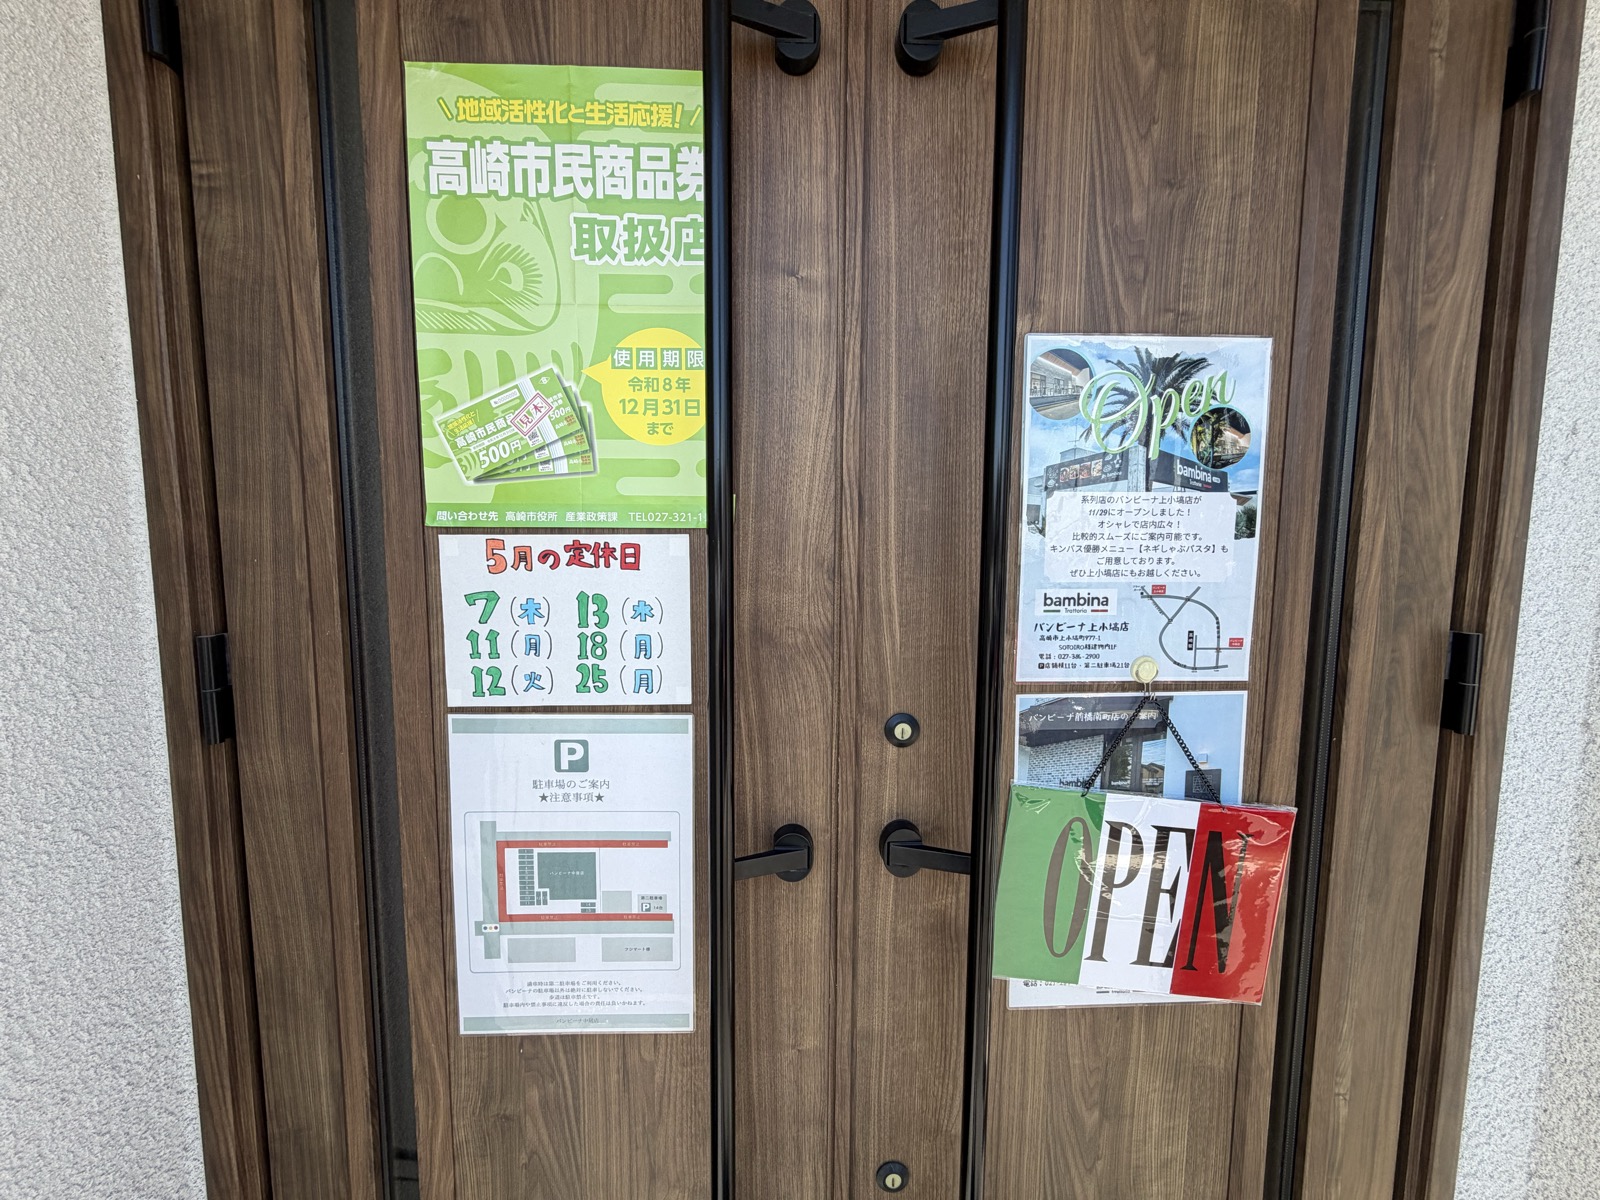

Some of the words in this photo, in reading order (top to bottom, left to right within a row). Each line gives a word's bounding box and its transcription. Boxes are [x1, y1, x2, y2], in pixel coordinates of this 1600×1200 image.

[570, 212, 704, 266] 取扱店
[612, 348, 705, 369] 使用期限
[627, 376, 692, 394] 令和8年
[618, 398, 701, 418] 12月31日
[1079, 368, 1236, 460] Open
[646, 421, 674, 436] まで
[1176, 459, 1212, 483] bambina
[1081, 495, 1202, 505] 系列店のバンビーナ上小塙店が
[436, 510, 499, 522] 問い合わせ先
[505, 511, 558, 522] 高崎市役所
[565, 511, 619, 522] 産業政策課
[628, 512, 707, 522] TEL027-321-1
[1097, 520, 1181, 529] オシャレで店内広々!
[1072, 532, 1203, 542] 比較的スムーズにご案内可能です。
[485, 538, 641, 574] 5月の定休日
[1096, 557, 1176, 566] ご用意しております。
[1069, 568, 1202, 578] ぜひ上小塙店にもお越しください。
[464, 590, 500, 624] 7
[510, 596, 550, 627] (木)
[576, 590, 610, 629] 13
[622, 597, 664, 625] (水)
[1043, 592, 1109, 607] bambina
[466, 629, 501, 659] 11
[511, 629, 553, 659] (月)
[577, 631, 608, 660] 18
[620, 630, 664, 661] (月)
[470, 665, 507, 697] 12
[511, 664, 554, 695] (火)
[576, 663, 609, 693] 25
[619, 664, 663, 695] (月)
[1029, 711, 1158, 722] バンビーナ前橋南町店の案内
[532, 779, 610, 790] 駐車場のご案内
[1043, 816, 1254, 974] OPEN
